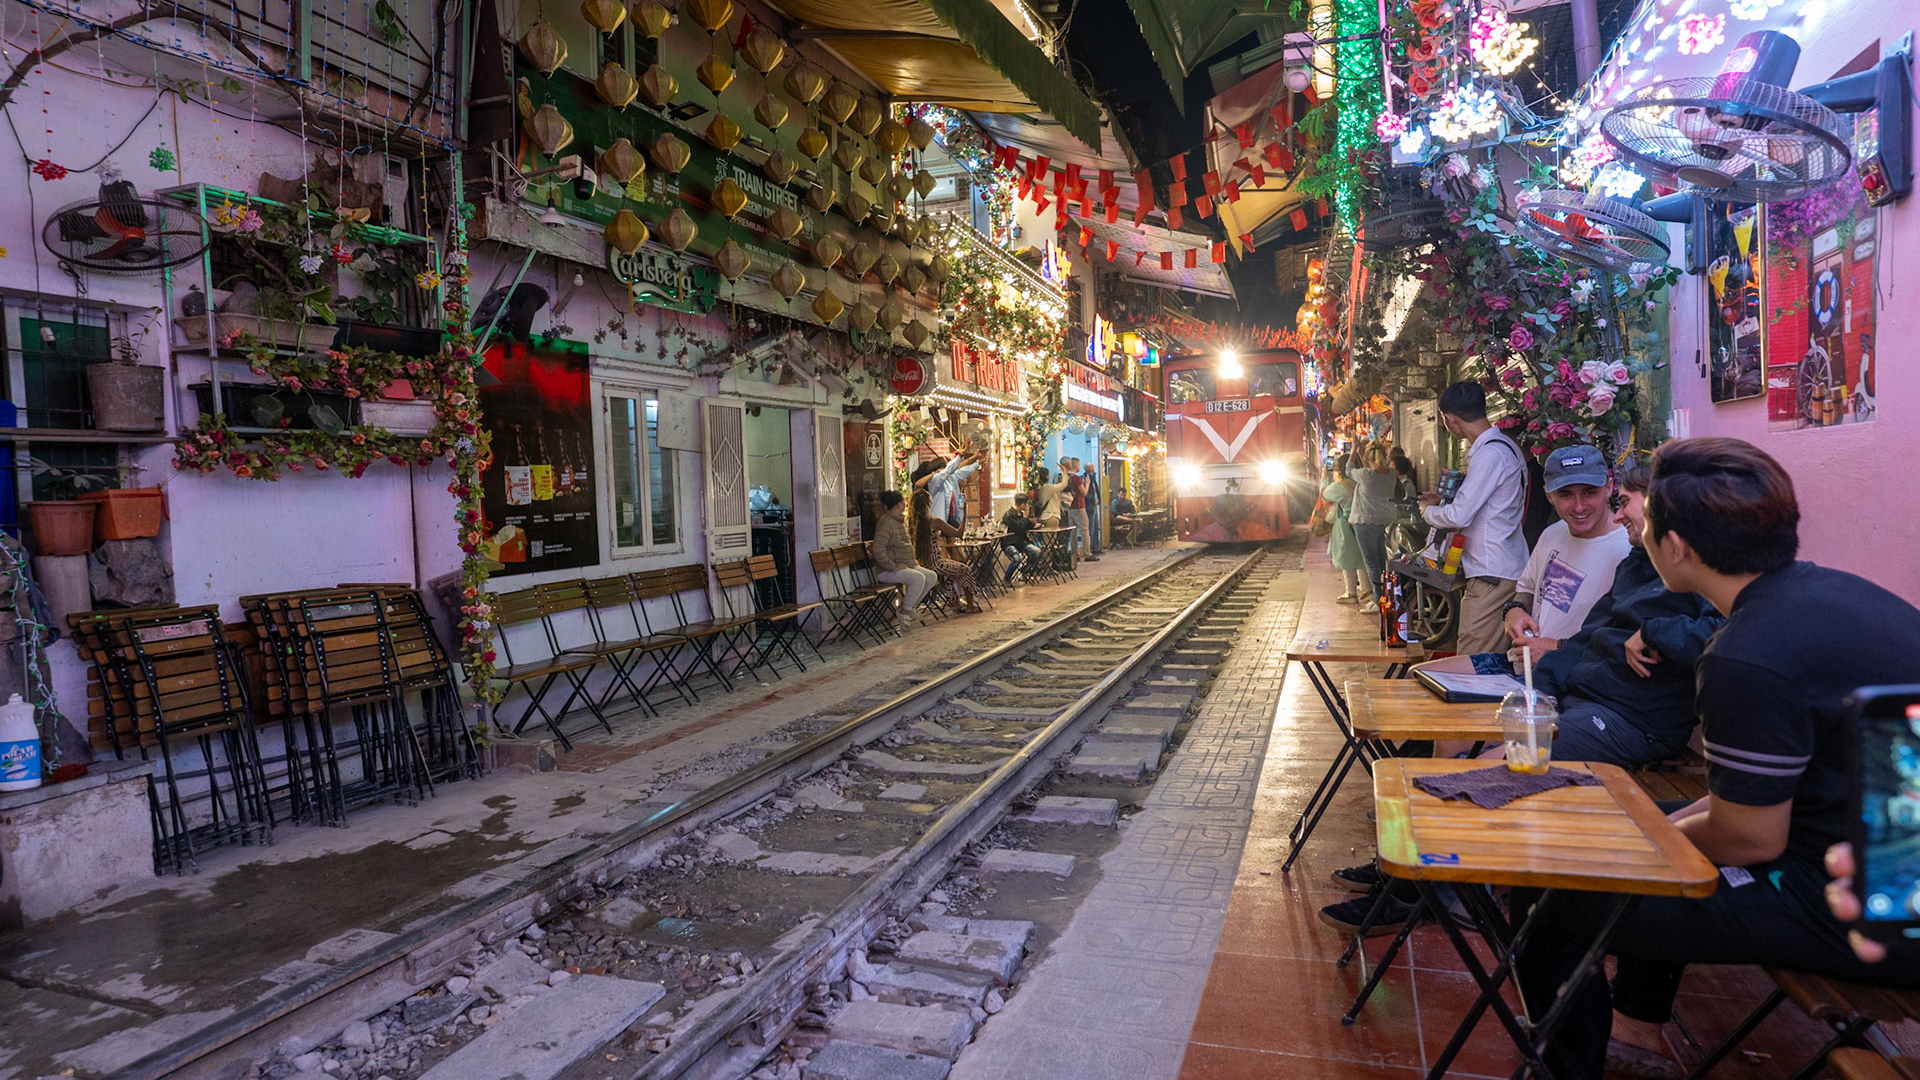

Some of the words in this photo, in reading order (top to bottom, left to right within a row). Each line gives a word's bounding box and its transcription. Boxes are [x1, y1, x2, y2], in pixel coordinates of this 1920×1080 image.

[732, 165, 763, 198] TRAIN
[764, 179, 798, 212] STREET
[731, 216, 765, 234] PREMIUM
[609, 248, 693, 299] Carlsberg
[950, 338, 973, 384] THE
[1, 744, 35, 761] POLAR
[13, 750, 37, 763] BEAR
